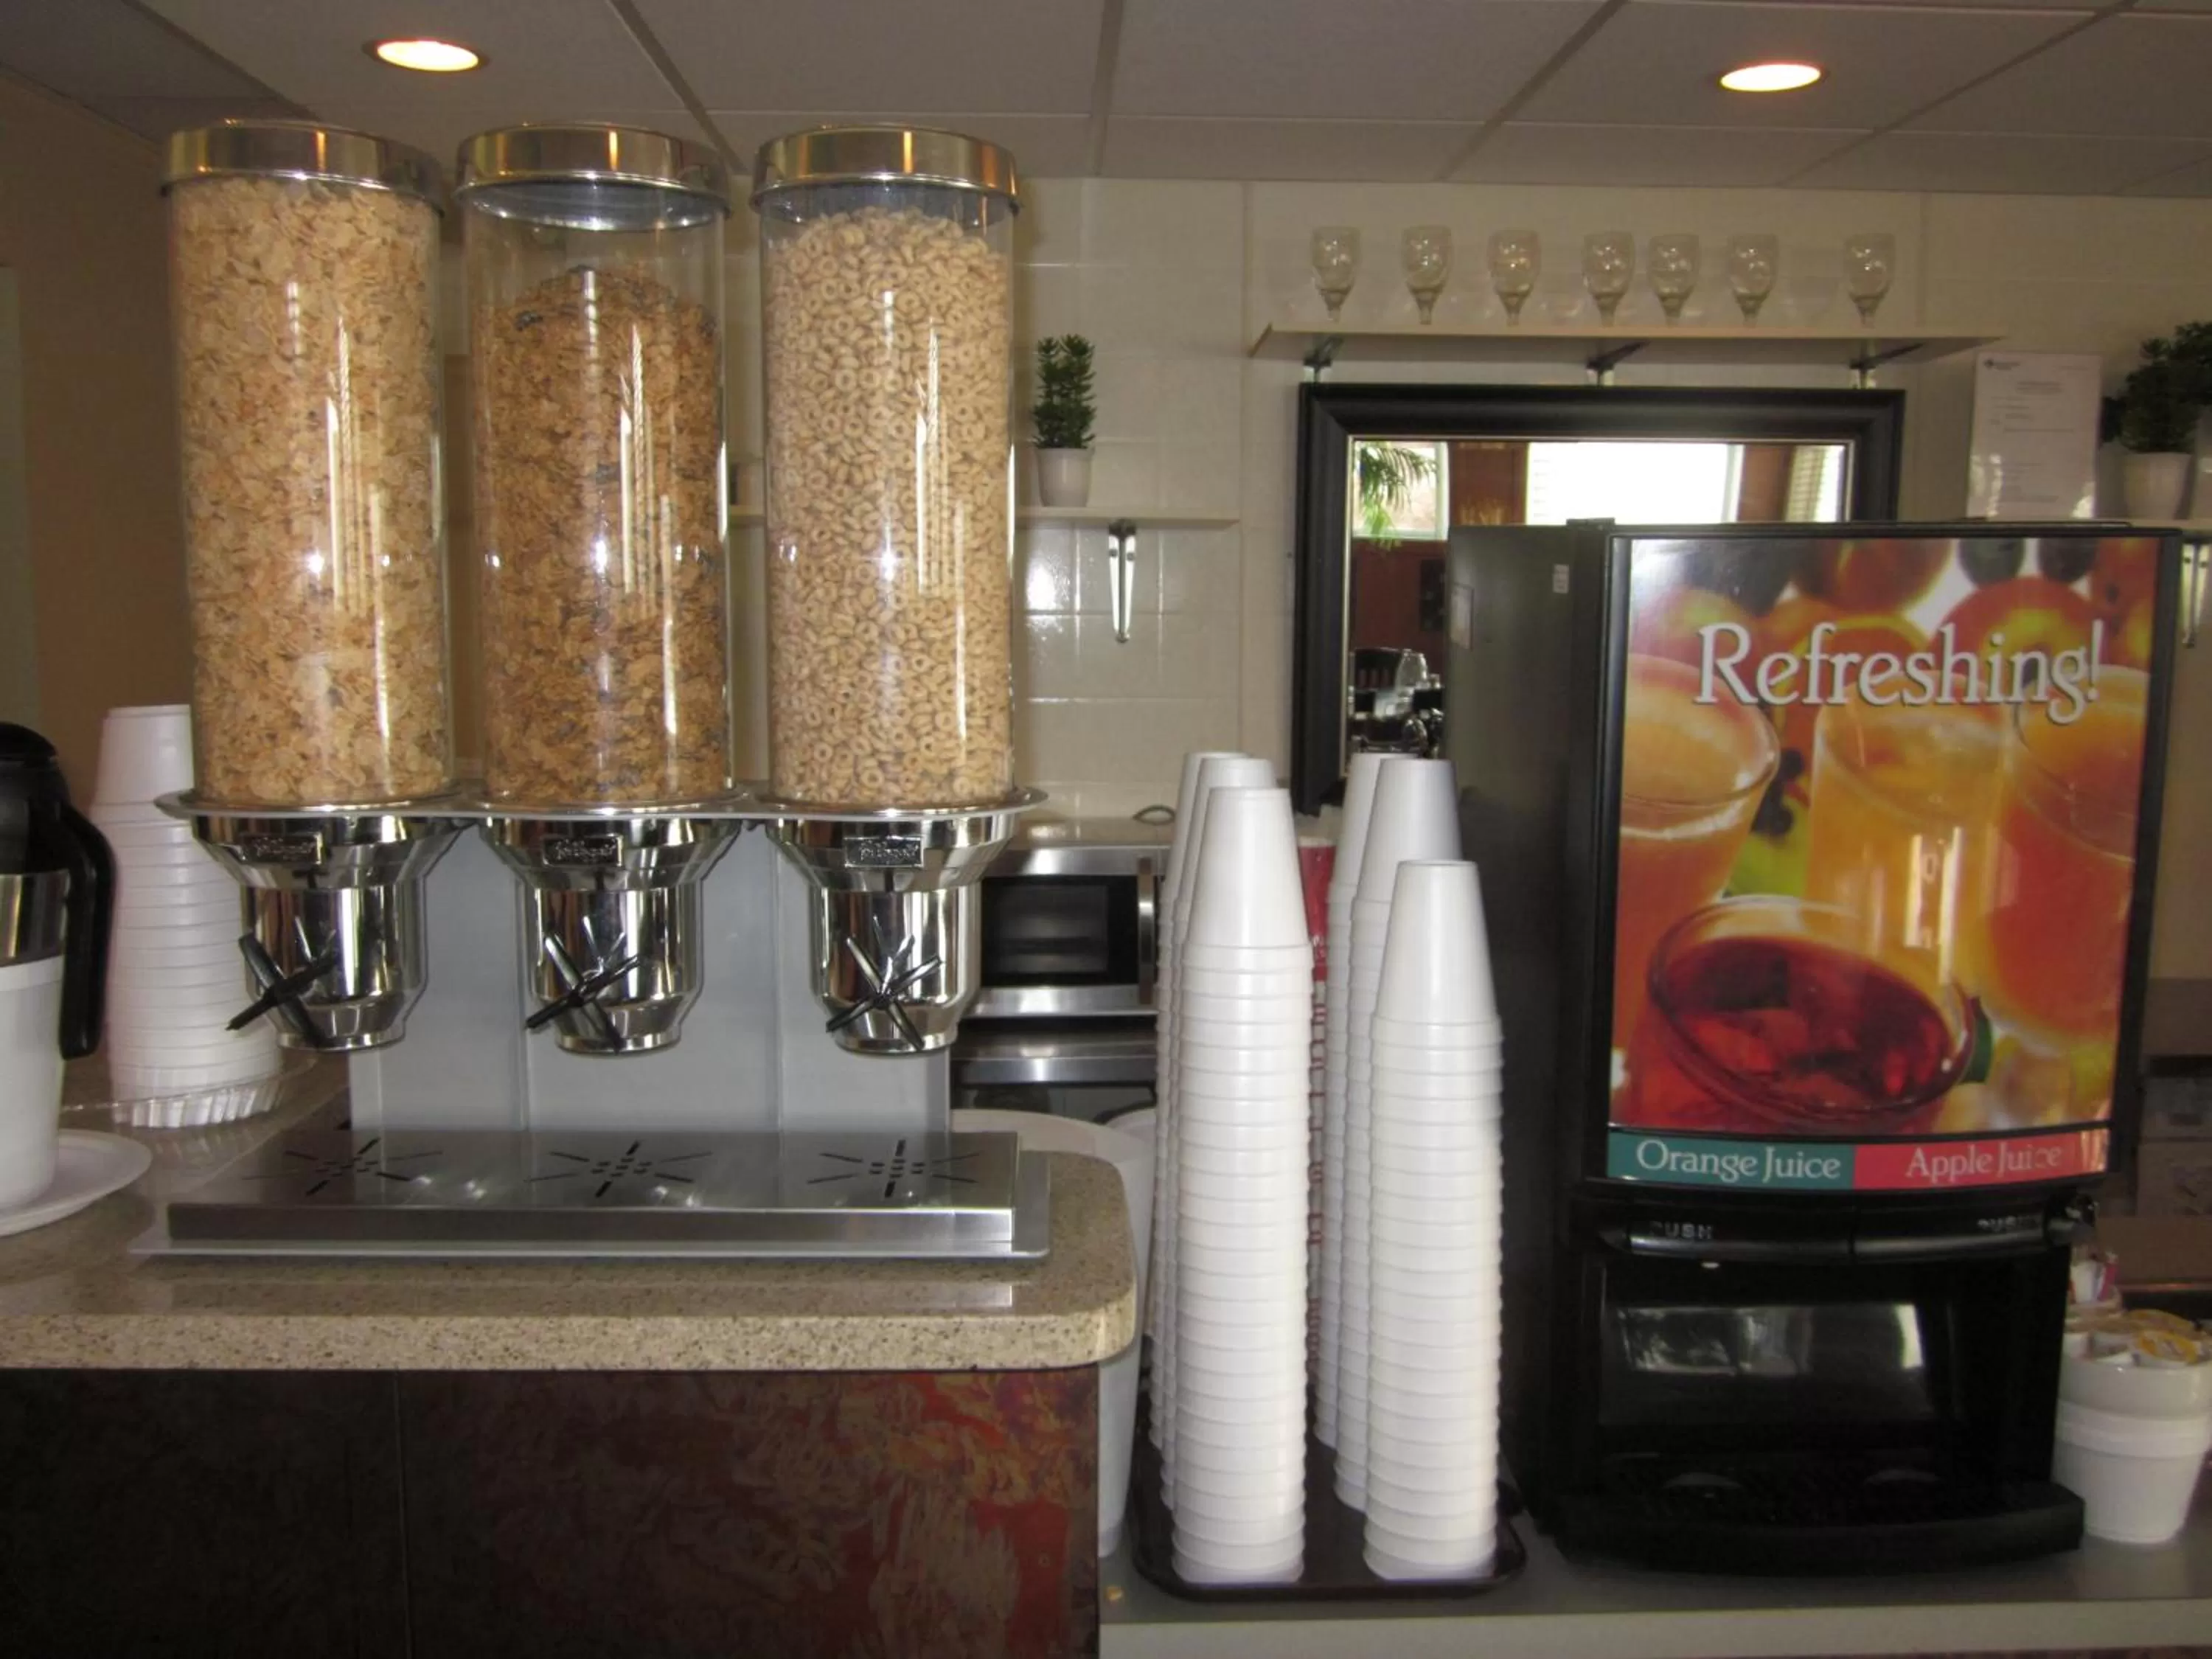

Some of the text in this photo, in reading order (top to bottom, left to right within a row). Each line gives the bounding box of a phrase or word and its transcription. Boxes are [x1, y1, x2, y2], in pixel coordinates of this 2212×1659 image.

[1694, 620, 2104, 725] Refreshing!
[1636, 1139, 1842, 1183] Orange Juice
[1905, 1141, 2062, 1184] Apple Juice
